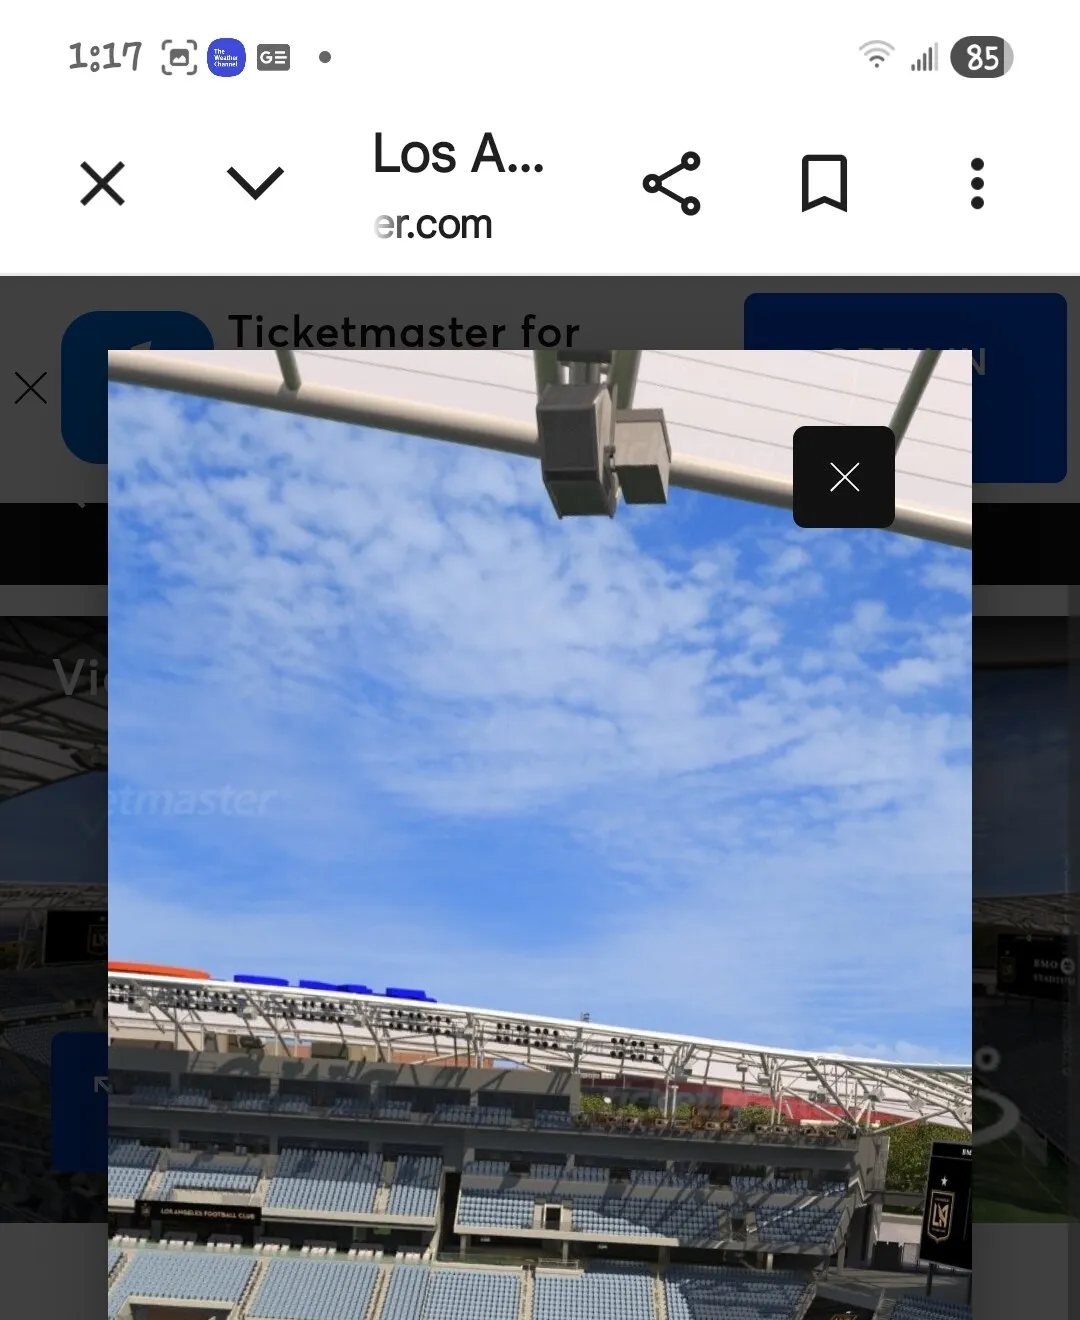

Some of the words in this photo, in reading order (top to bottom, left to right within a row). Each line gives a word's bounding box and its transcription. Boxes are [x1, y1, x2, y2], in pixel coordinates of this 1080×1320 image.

[69, 41, 142, 72] 1:17
[967, 44, 999, 71] 85
[375, 132, 456, 173] Los
[471, 132, 543, 172] A...
[374, 215, 492, 239] er.com
[228, 314, 505, 348] Ticketmaster
[522, 314, 580, 348] for
[52, 658, 108, 695] Vi
